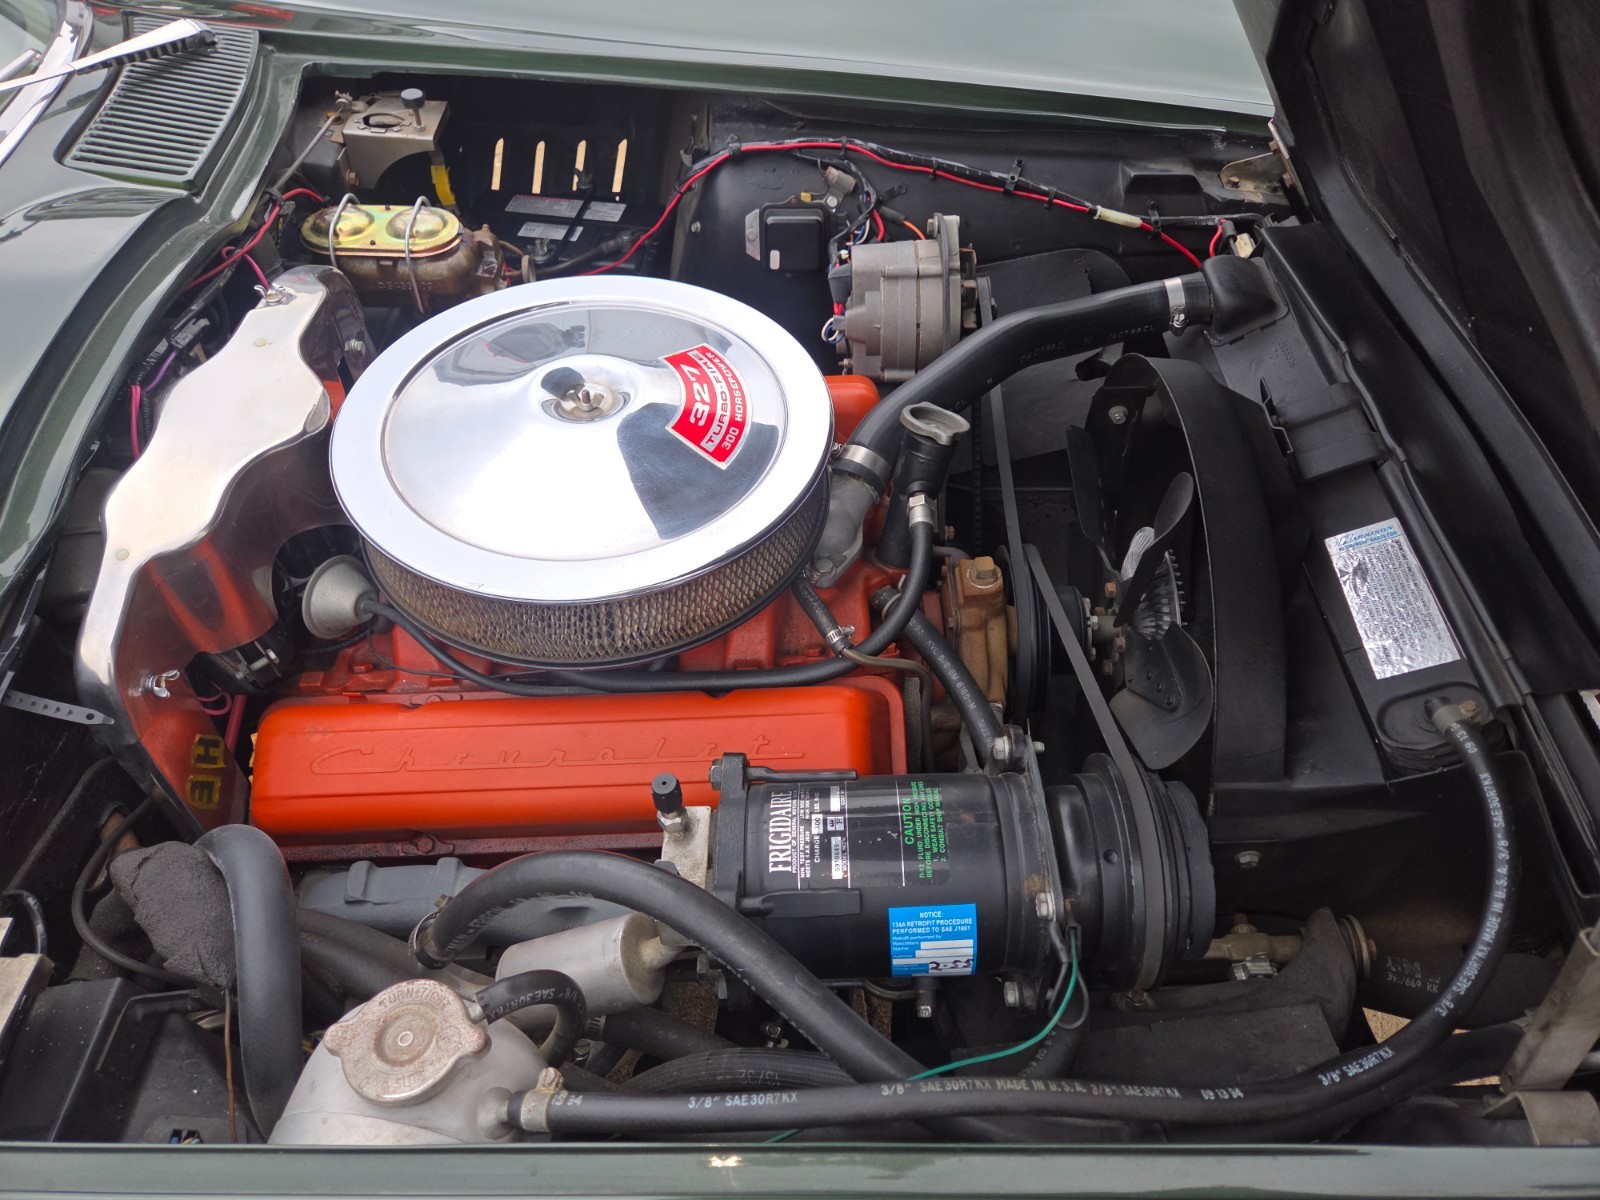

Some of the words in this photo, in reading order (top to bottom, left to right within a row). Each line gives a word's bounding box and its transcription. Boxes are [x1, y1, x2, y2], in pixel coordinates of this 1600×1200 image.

[680, 364, 711, 427] 327
[691, 351, 729, 445] TURBO-FIRE
[706, 352, 743, 422] HORSEPOWER
[721, 427, 740, 450] 300
[1456, 730, 1469, 742] 13
[1464, 741, 1479, 754] 09
[310, 736, 805, 775] Chevrolet
[1479, 771, 1505, 828] SAE30R7KX
[769, 791, 792, 873] FRIGIDAIRE
[902, 797, 915, 845] CAUTION
[921, 802, 931, 849] DISCONNECTING
[929, 811, 937, 833] SAFETY
[813, 835, 821, 863] CHARGE
[938, 824, 946, 854] CONSULT
[1496, 834, 1510, 860] 3/8"
[1490, 901, 1504, 914] IN
[906, 919, 935, 928] RETROFIT
[936, 917, 973, 926] PROCEDURE
[1482, 915, 1501, 943] MADE
[1452, 943, 1491, 995] SAE30R7KX
[378, 987, 414, 1009] TURN
[1434, 994, 1454, 1017] 3/8"
[1318, 1069, 1341, 1086] 3/8"
[1342, 1046, 1396, 1077] SAE30R7KX
[688, 1096, 720, 1109] 3/8"
[725, 1092, 798, 1108] SAE30R7KX
[880, 1083, 911, 1096] 3/8"
[920, 1079, 992, 1093] SAE30R7KX
[996, 1079, 1030, 1091] MADE
[1032, 1080, 1046, 1091] IN
[1121, 1085, 1183, 1099] SAE30R7KX
[1216, 1088, 1229, 1099] 13
